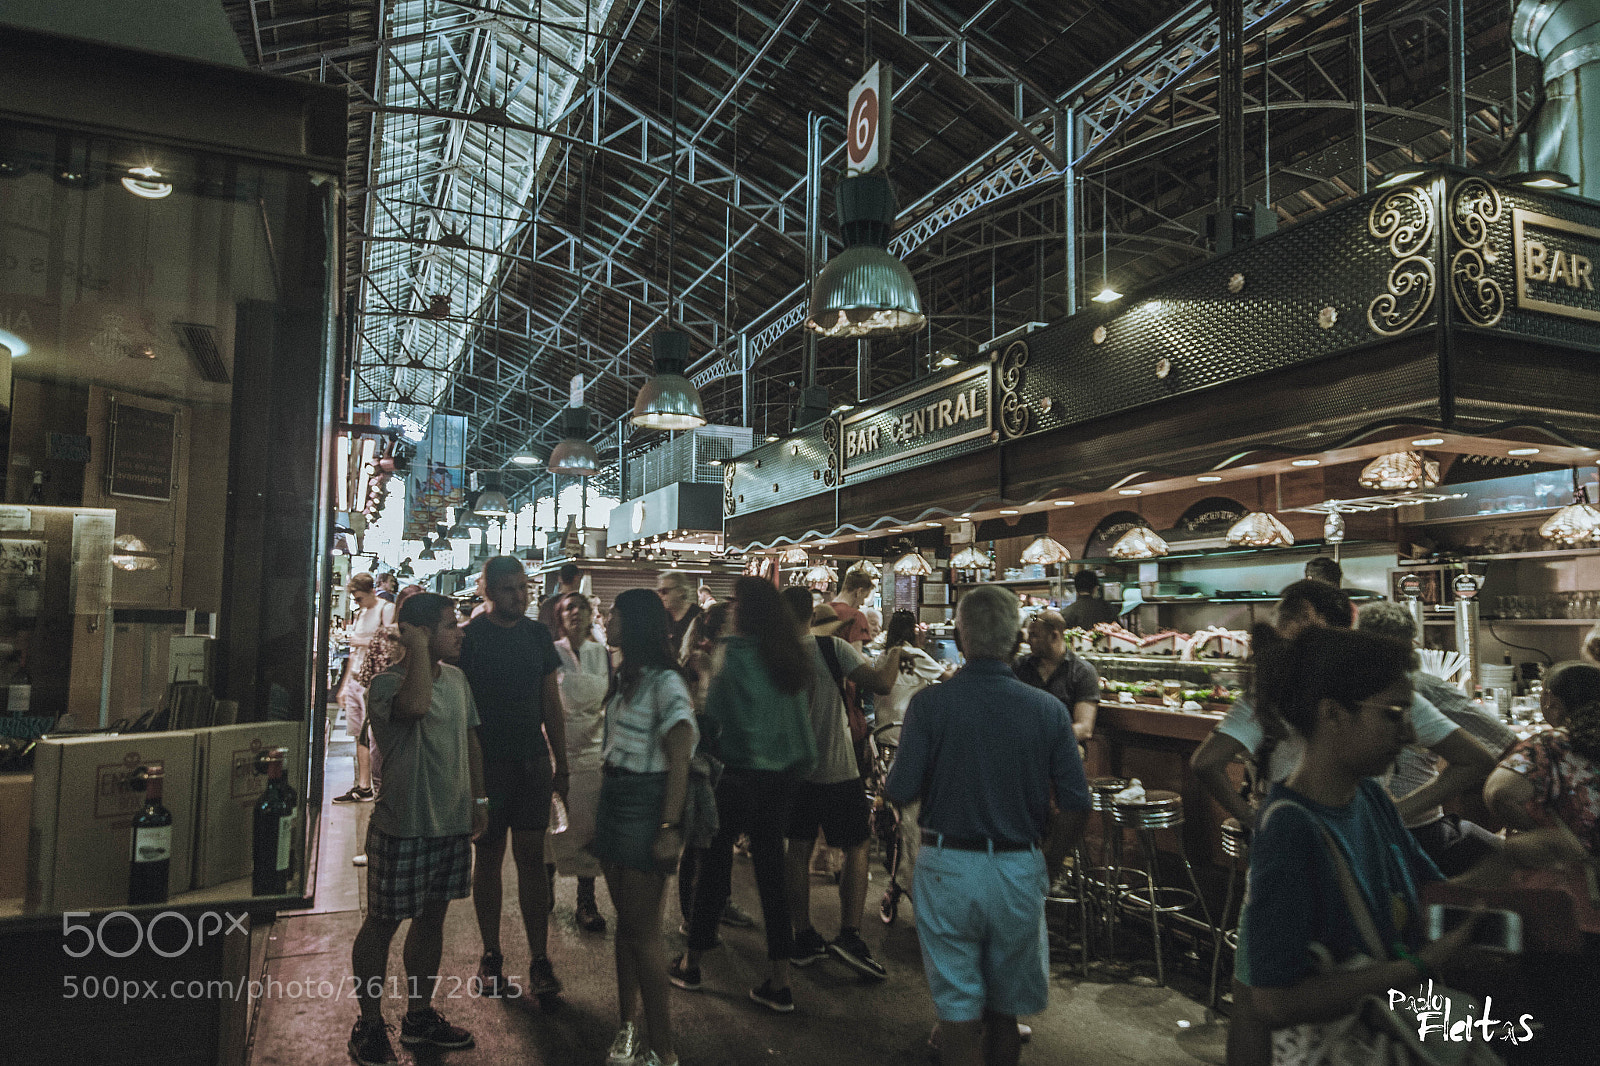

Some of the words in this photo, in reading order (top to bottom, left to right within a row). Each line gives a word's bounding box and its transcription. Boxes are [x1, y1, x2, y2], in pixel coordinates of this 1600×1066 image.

[856, 100, 870, 150] 6
[1525, 240, 1595, 291] BAR
[846, 426, 881, 459] BAR
[890, 389, 984, 443] CENTRAL
